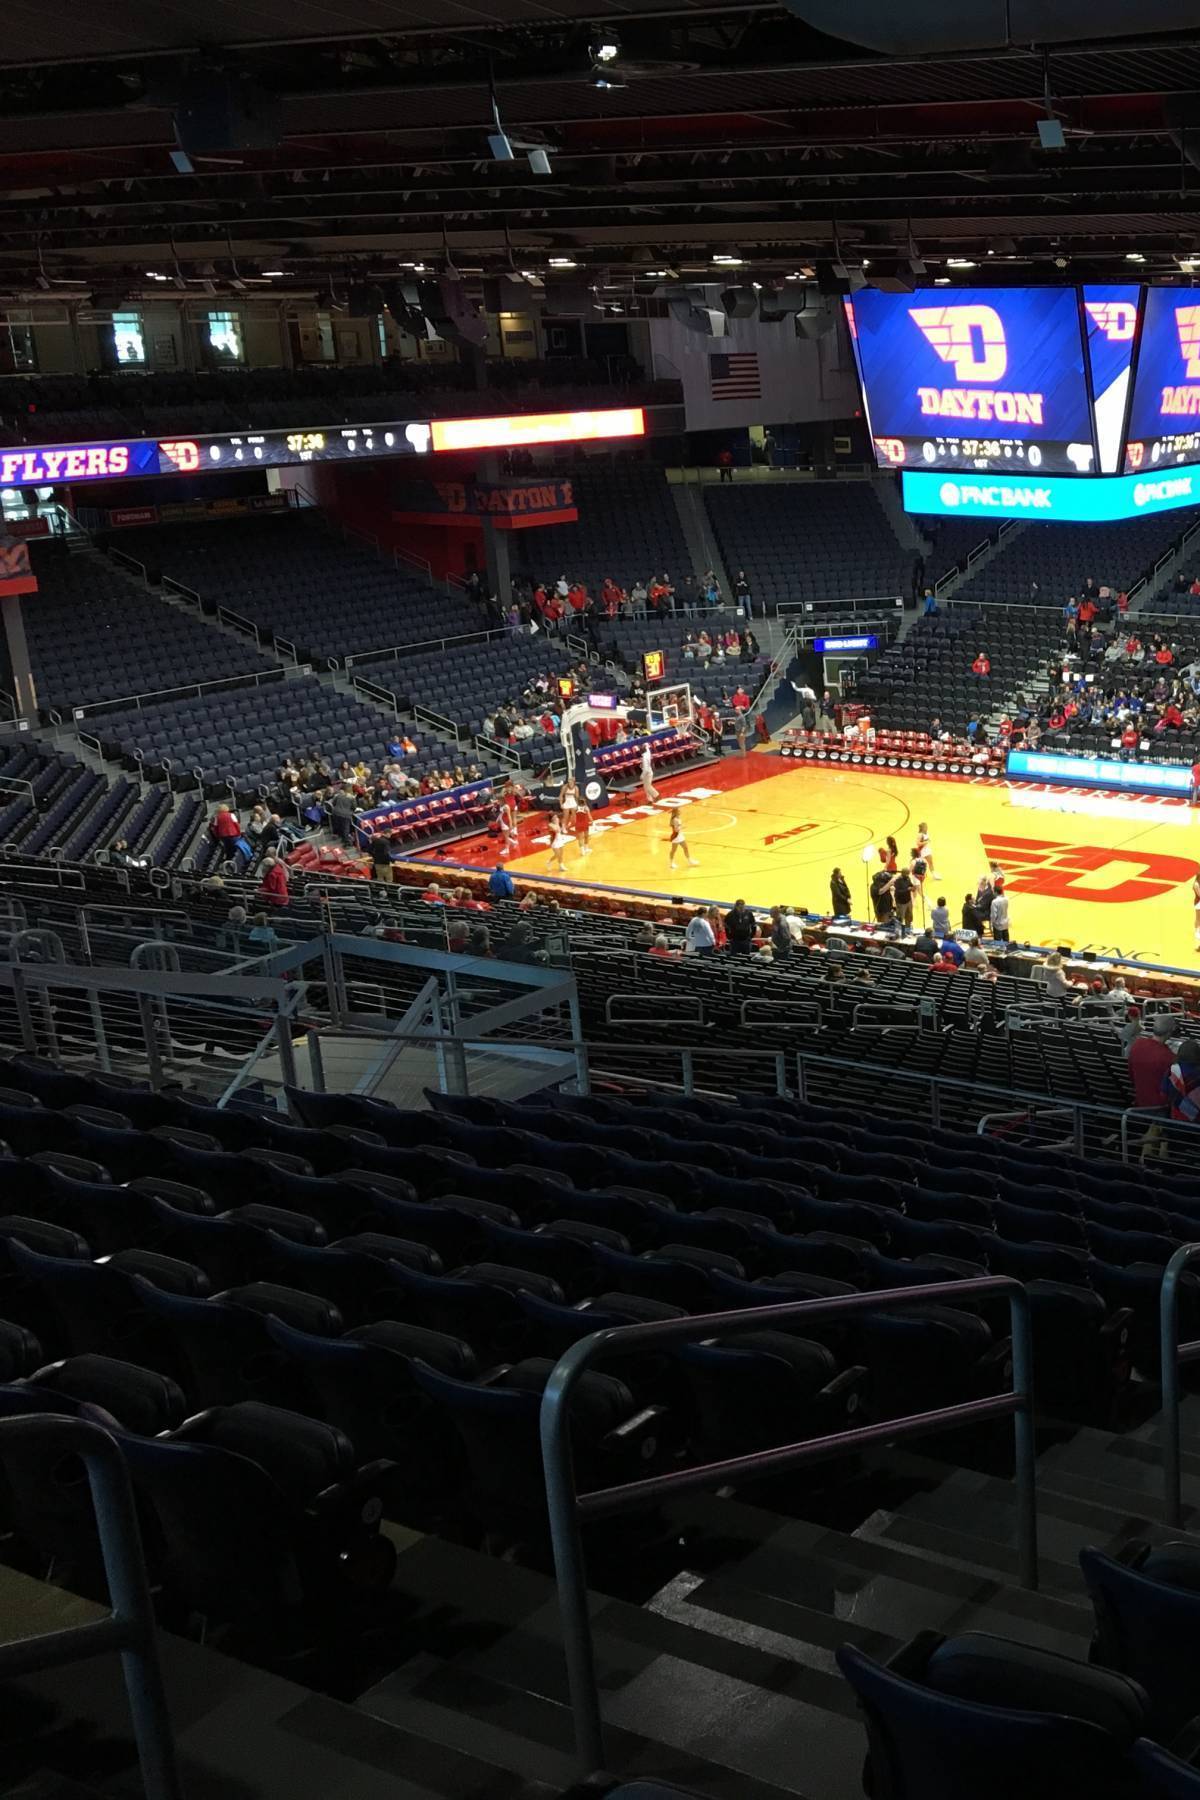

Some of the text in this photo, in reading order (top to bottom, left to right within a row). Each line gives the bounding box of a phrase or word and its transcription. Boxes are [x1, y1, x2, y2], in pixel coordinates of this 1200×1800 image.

[917, 388, 1043, 425] DAYTON
[1, 447, 128, 482] FLYERS
[1078, 943, 1160, 962] PNC
